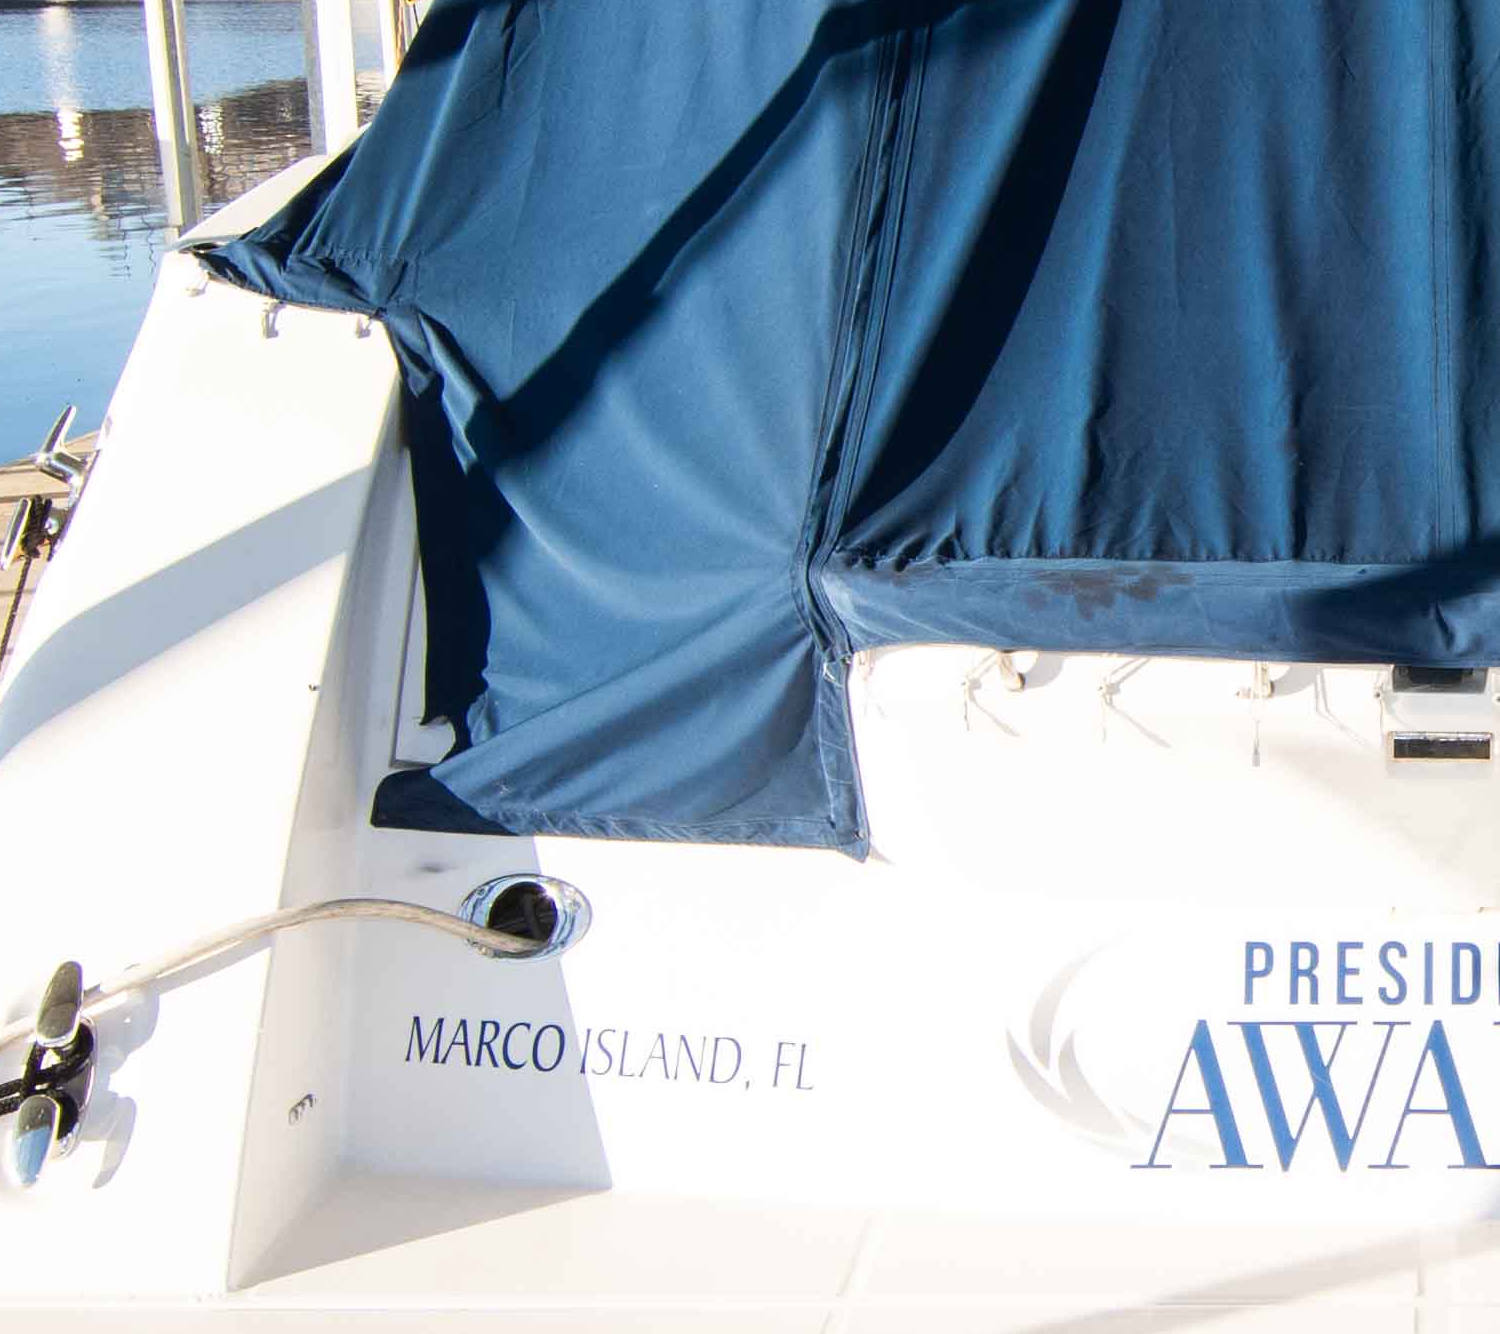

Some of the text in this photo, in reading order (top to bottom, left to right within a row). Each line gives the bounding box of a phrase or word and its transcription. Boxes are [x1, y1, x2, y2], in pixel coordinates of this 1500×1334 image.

[404, 1015, 816, 1092] MARCO ISLAND, FL
